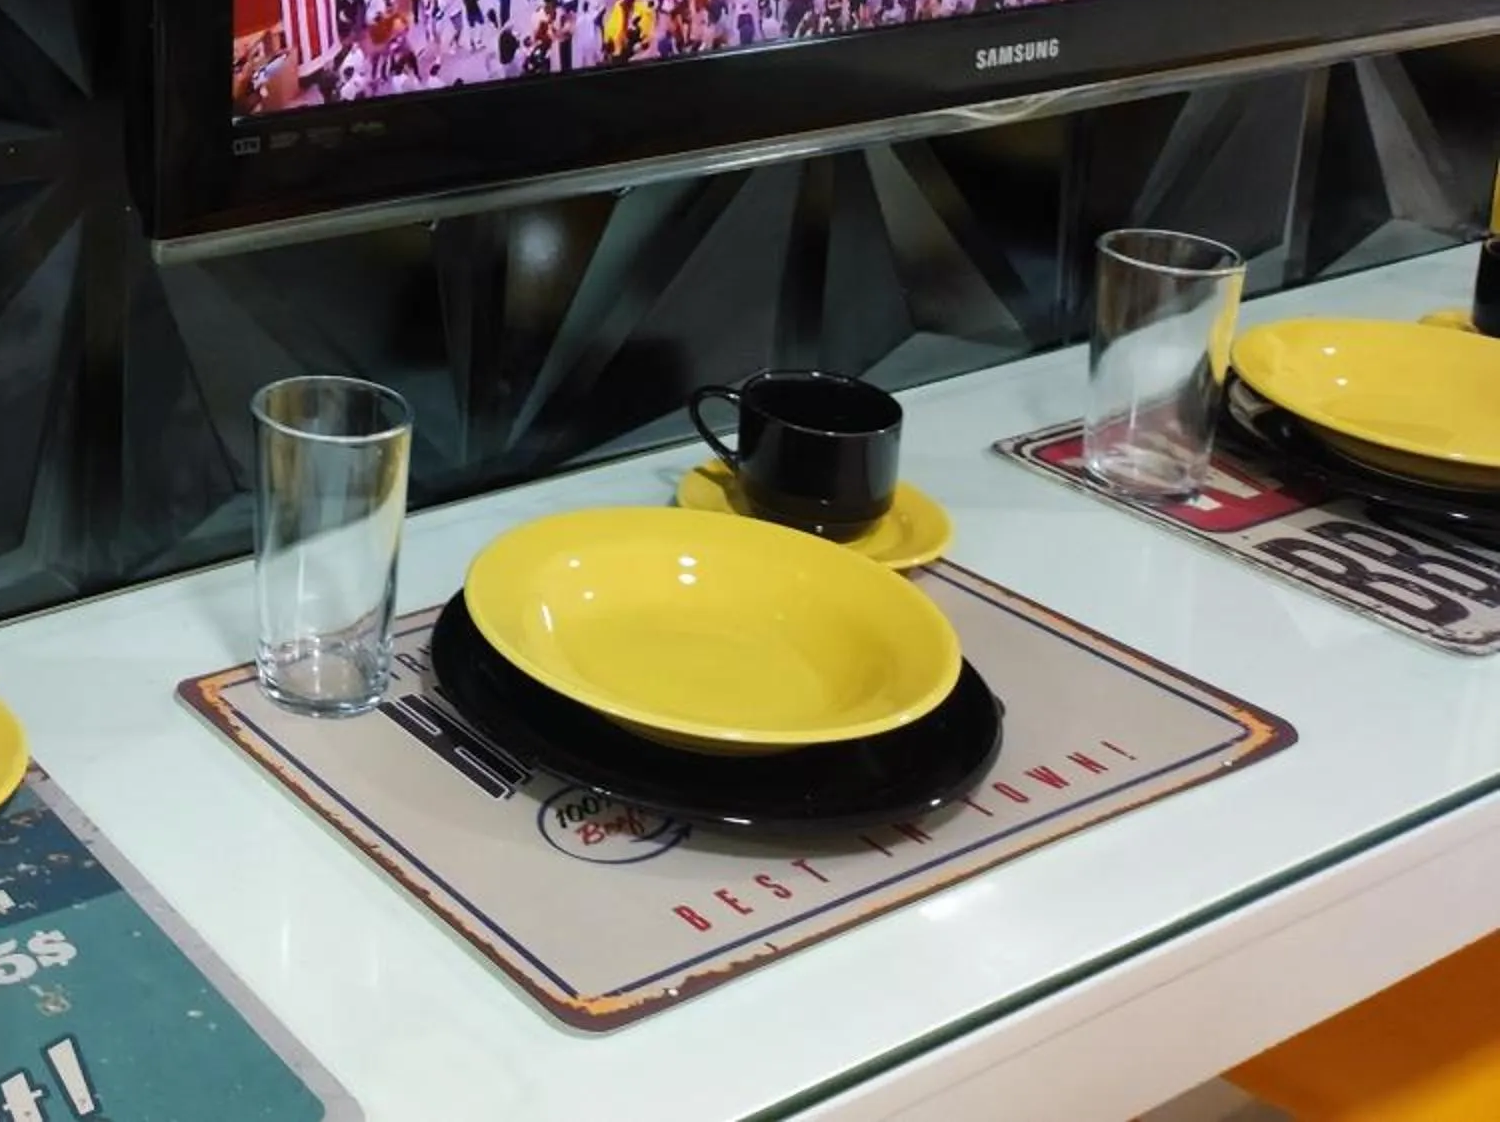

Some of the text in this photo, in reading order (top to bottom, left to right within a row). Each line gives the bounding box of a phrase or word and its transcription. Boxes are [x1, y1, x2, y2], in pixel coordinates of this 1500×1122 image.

[975, 38, 1060, 70] SAMSUNG
[1253, 503, 1500, 626] BB
[672, 740, 1138, 933] BEST IN TOWN!
